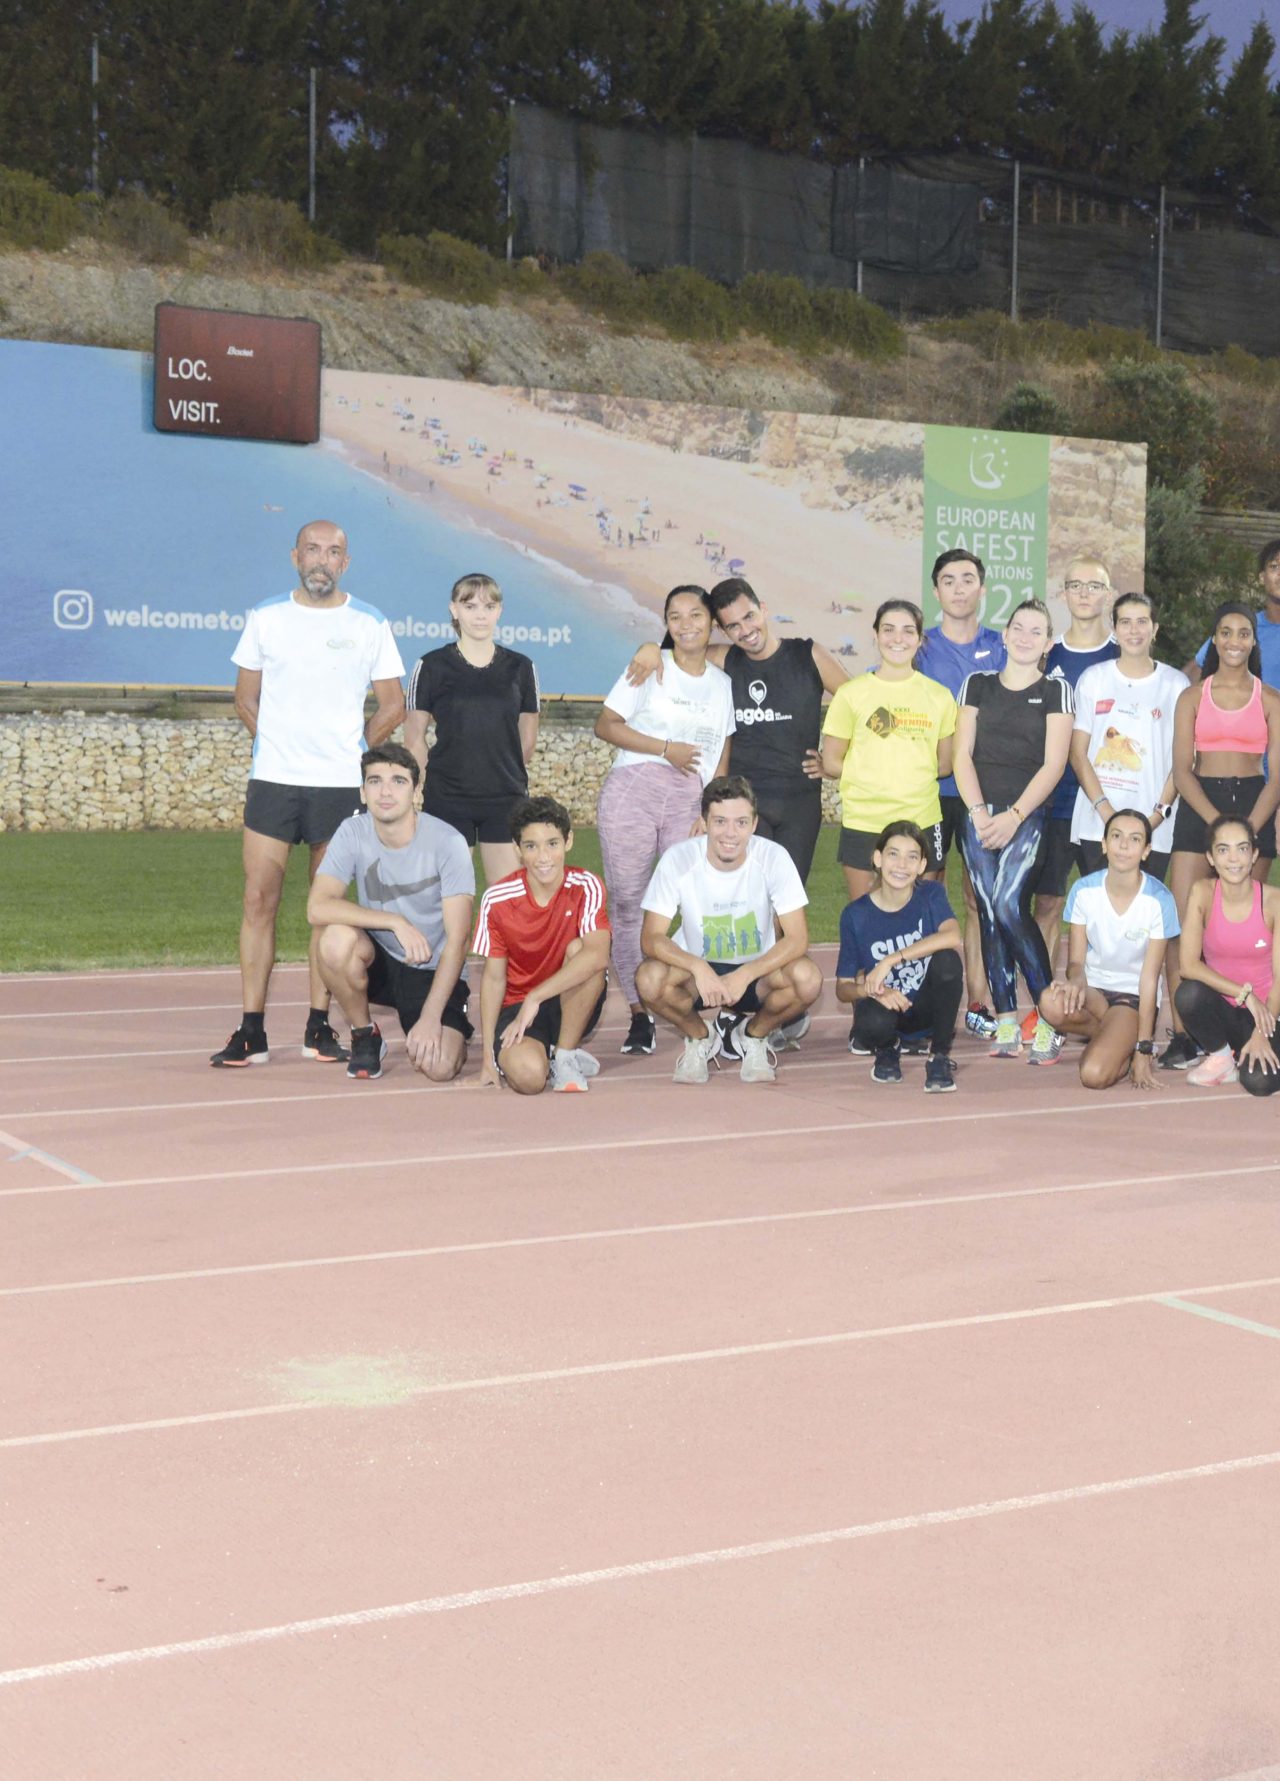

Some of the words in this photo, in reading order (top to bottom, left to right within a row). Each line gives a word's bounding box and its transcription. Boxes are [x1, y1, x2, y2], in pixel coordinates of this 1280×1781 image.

[168, 357, 212, 381] LOC.
[168, 398, 221, 424] VISIT.
[936, 506, 1035, 532] EUROPEAN
[936, 530, 1035, 562] SAFEST
[735, 707, 775, 725] agoa
